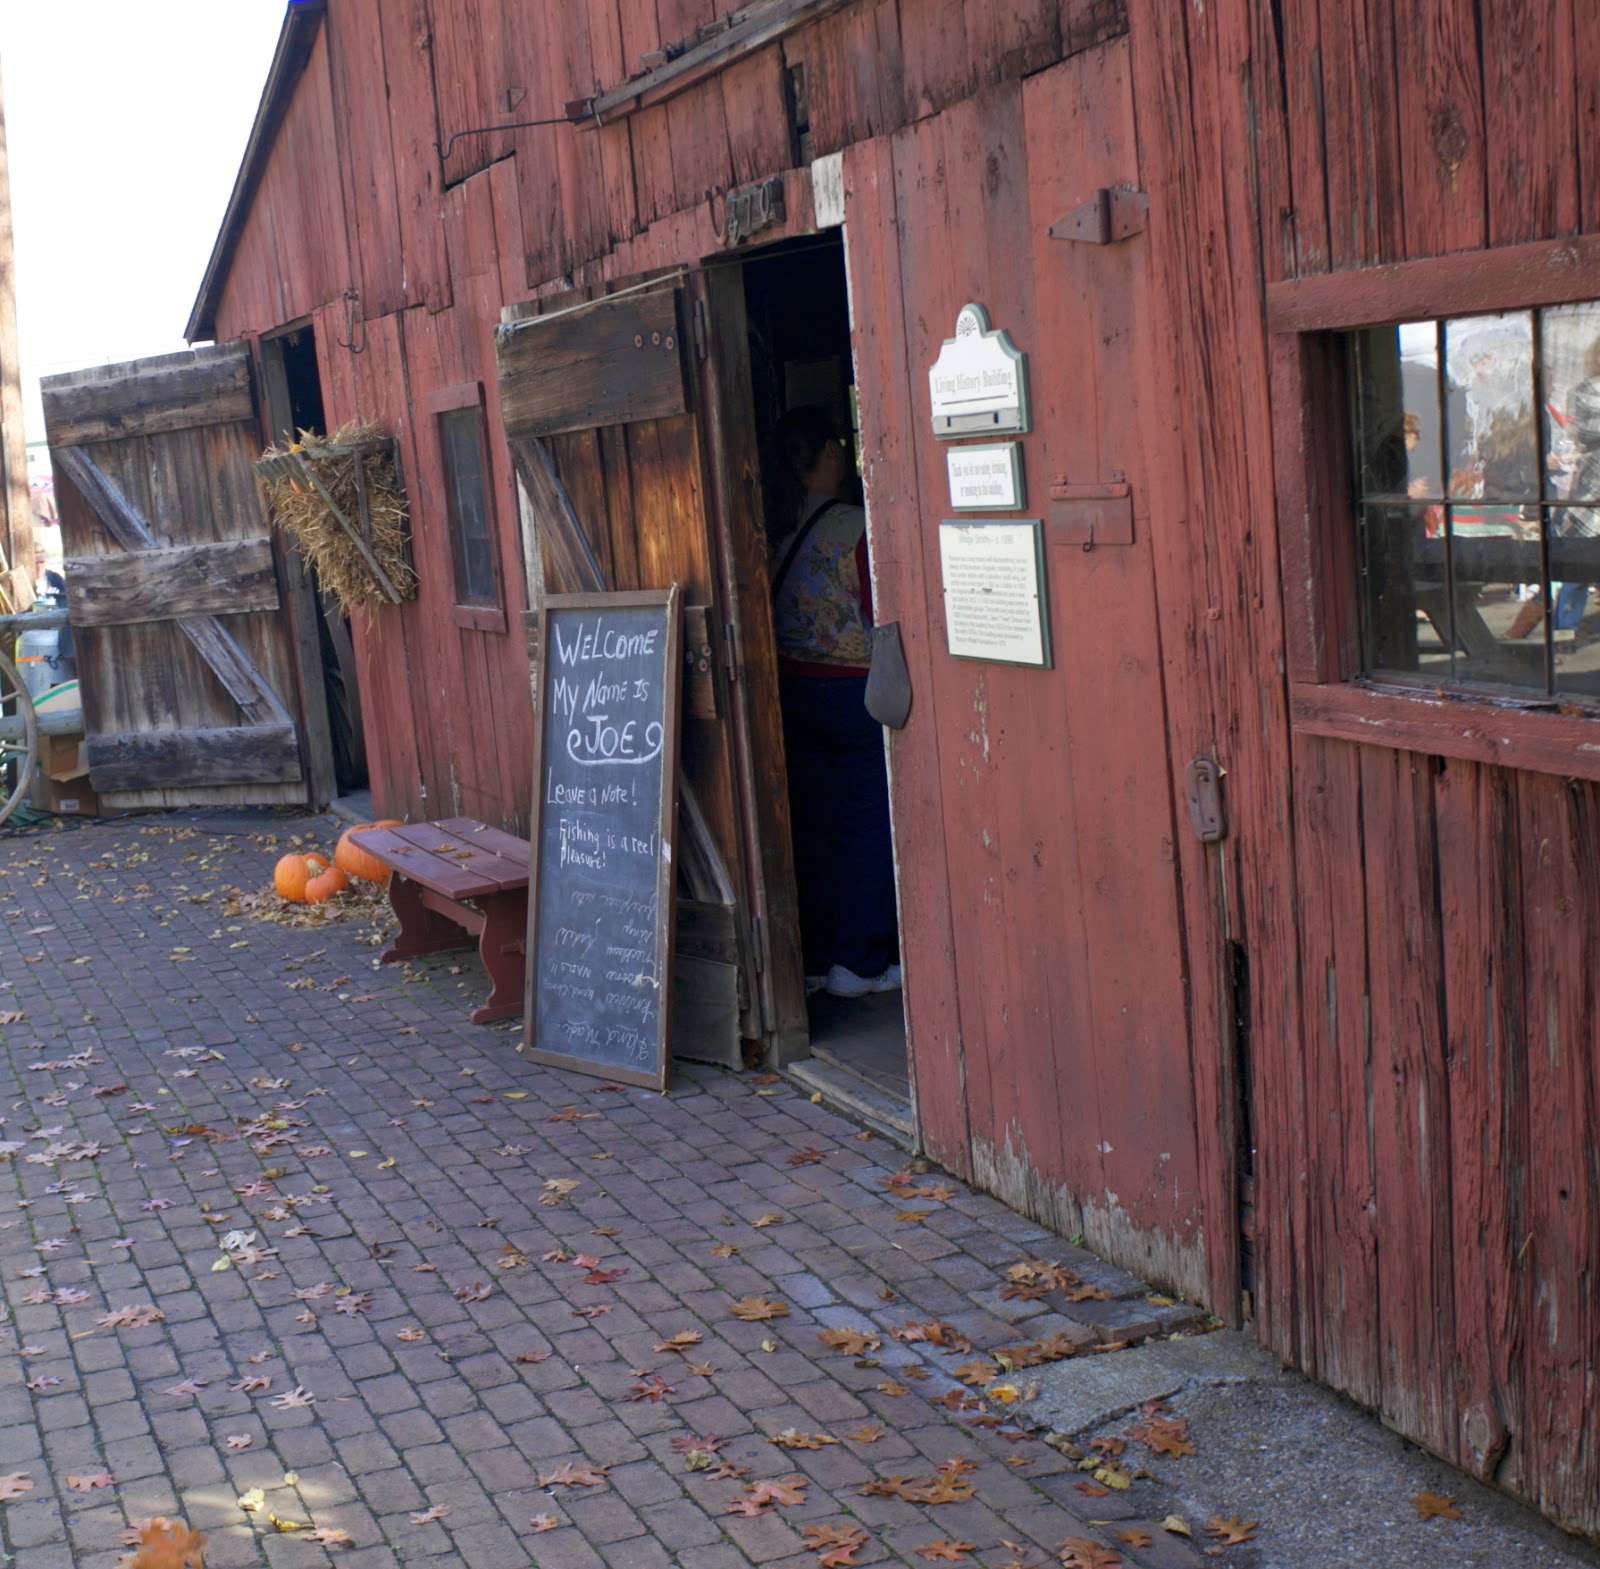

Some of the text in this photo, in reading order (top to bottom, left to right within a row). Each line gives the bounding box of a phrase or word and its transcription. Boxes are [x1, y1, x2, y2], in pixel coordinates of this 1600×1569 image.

[935, 368, 1012, 396] Living History Building
[553, 676, 579, 727] My
[585, 715, 637, 757] JOE
[559, 818, 655, 857] Fishing is a reel
